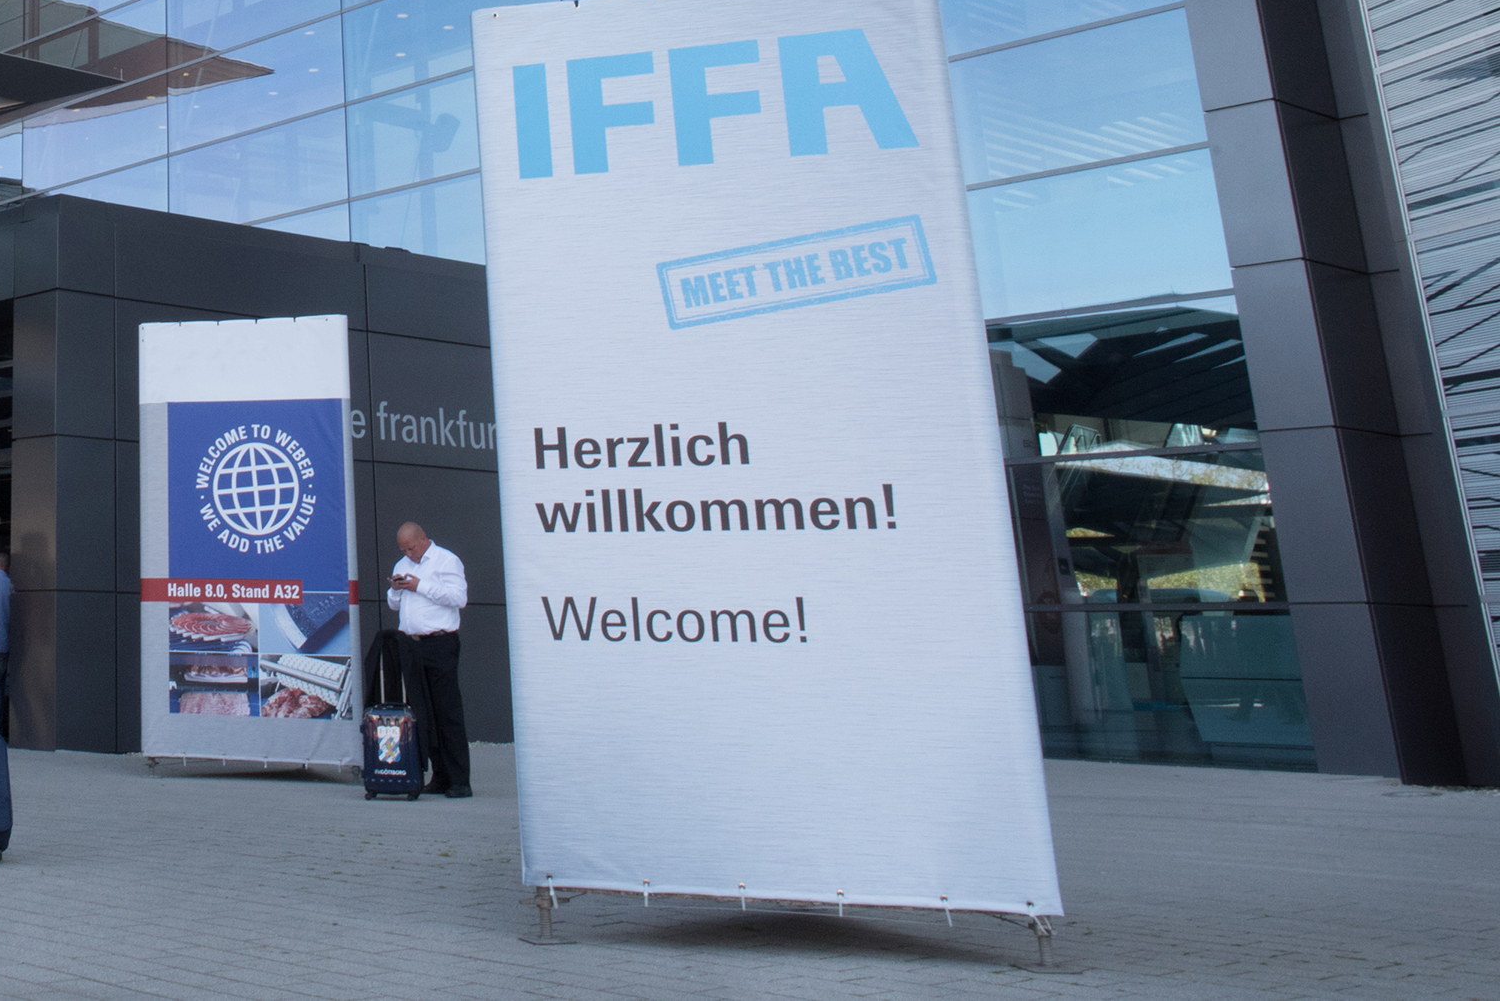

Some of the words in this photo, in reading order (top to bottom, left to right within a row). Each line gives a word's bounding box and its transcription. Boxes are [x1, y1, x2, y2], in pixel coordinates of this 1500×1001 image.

[512, 28, 920, 180] IFFA
[679, 264, 758, 309] MEET
[762, 252, 826, 293] THE
[828, 237, 909, 281] BEST
[376, 400, 496, 450] frankfur
[533, 421, 751, 470] Herzlich
[195, 425, 248, 489] WELCOME
[251, 423, 271, 439] TO
[274, 429, 315, 480] WEBER
[199, 502, 222, 532] WE
[217, 528, 250, 553] ADD
[253, 534, 285, 554] THE
[282, 493, 317, 541] VALUE
[535, 483, 898, 533] willkommen!
[167, 582, 202, 598] Halle
[204, 583, 228, 600] 8.0,
[231, 583, 270, 599] Stand
[273, 584, 300, 599] A32
[541, 596, 808, 644] Welcome!
